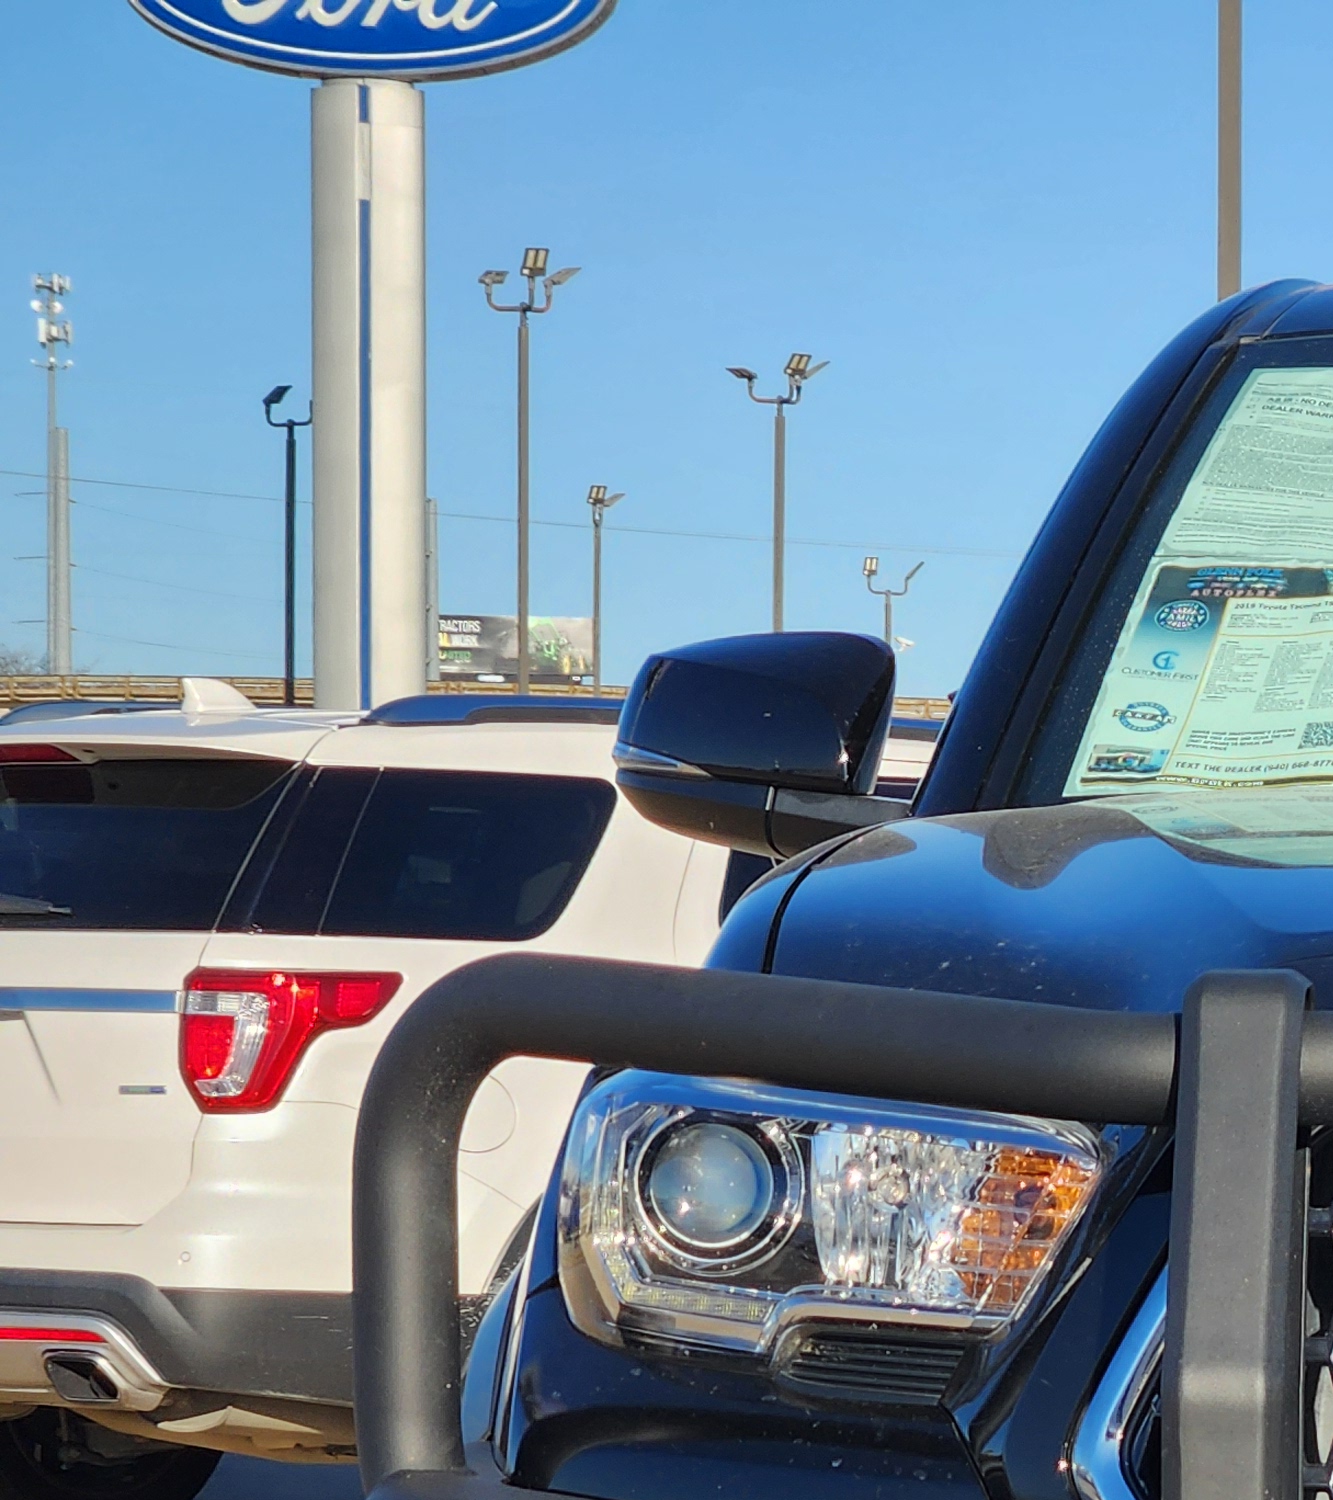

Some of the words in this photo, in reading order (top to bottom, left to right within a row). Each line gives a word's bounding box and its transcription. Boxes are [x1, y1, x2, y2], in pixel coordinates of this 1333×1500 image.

[1261, 404, 1303, 414] DEALER
[1197, 567, 1244, 577] GLENN
[1190, 589, 1278, 597] AUTOPLEX
[1259, 602, 1288, 610] Toyota
[438, 620, 482, 634] RACTORS
[1175, 761, 1200, 770] TEXT
[1203, 764, 1221, 772] THE
[1224, 765, 1262, 773] DEALER
[1263, 763, 1290, 773] (940)
